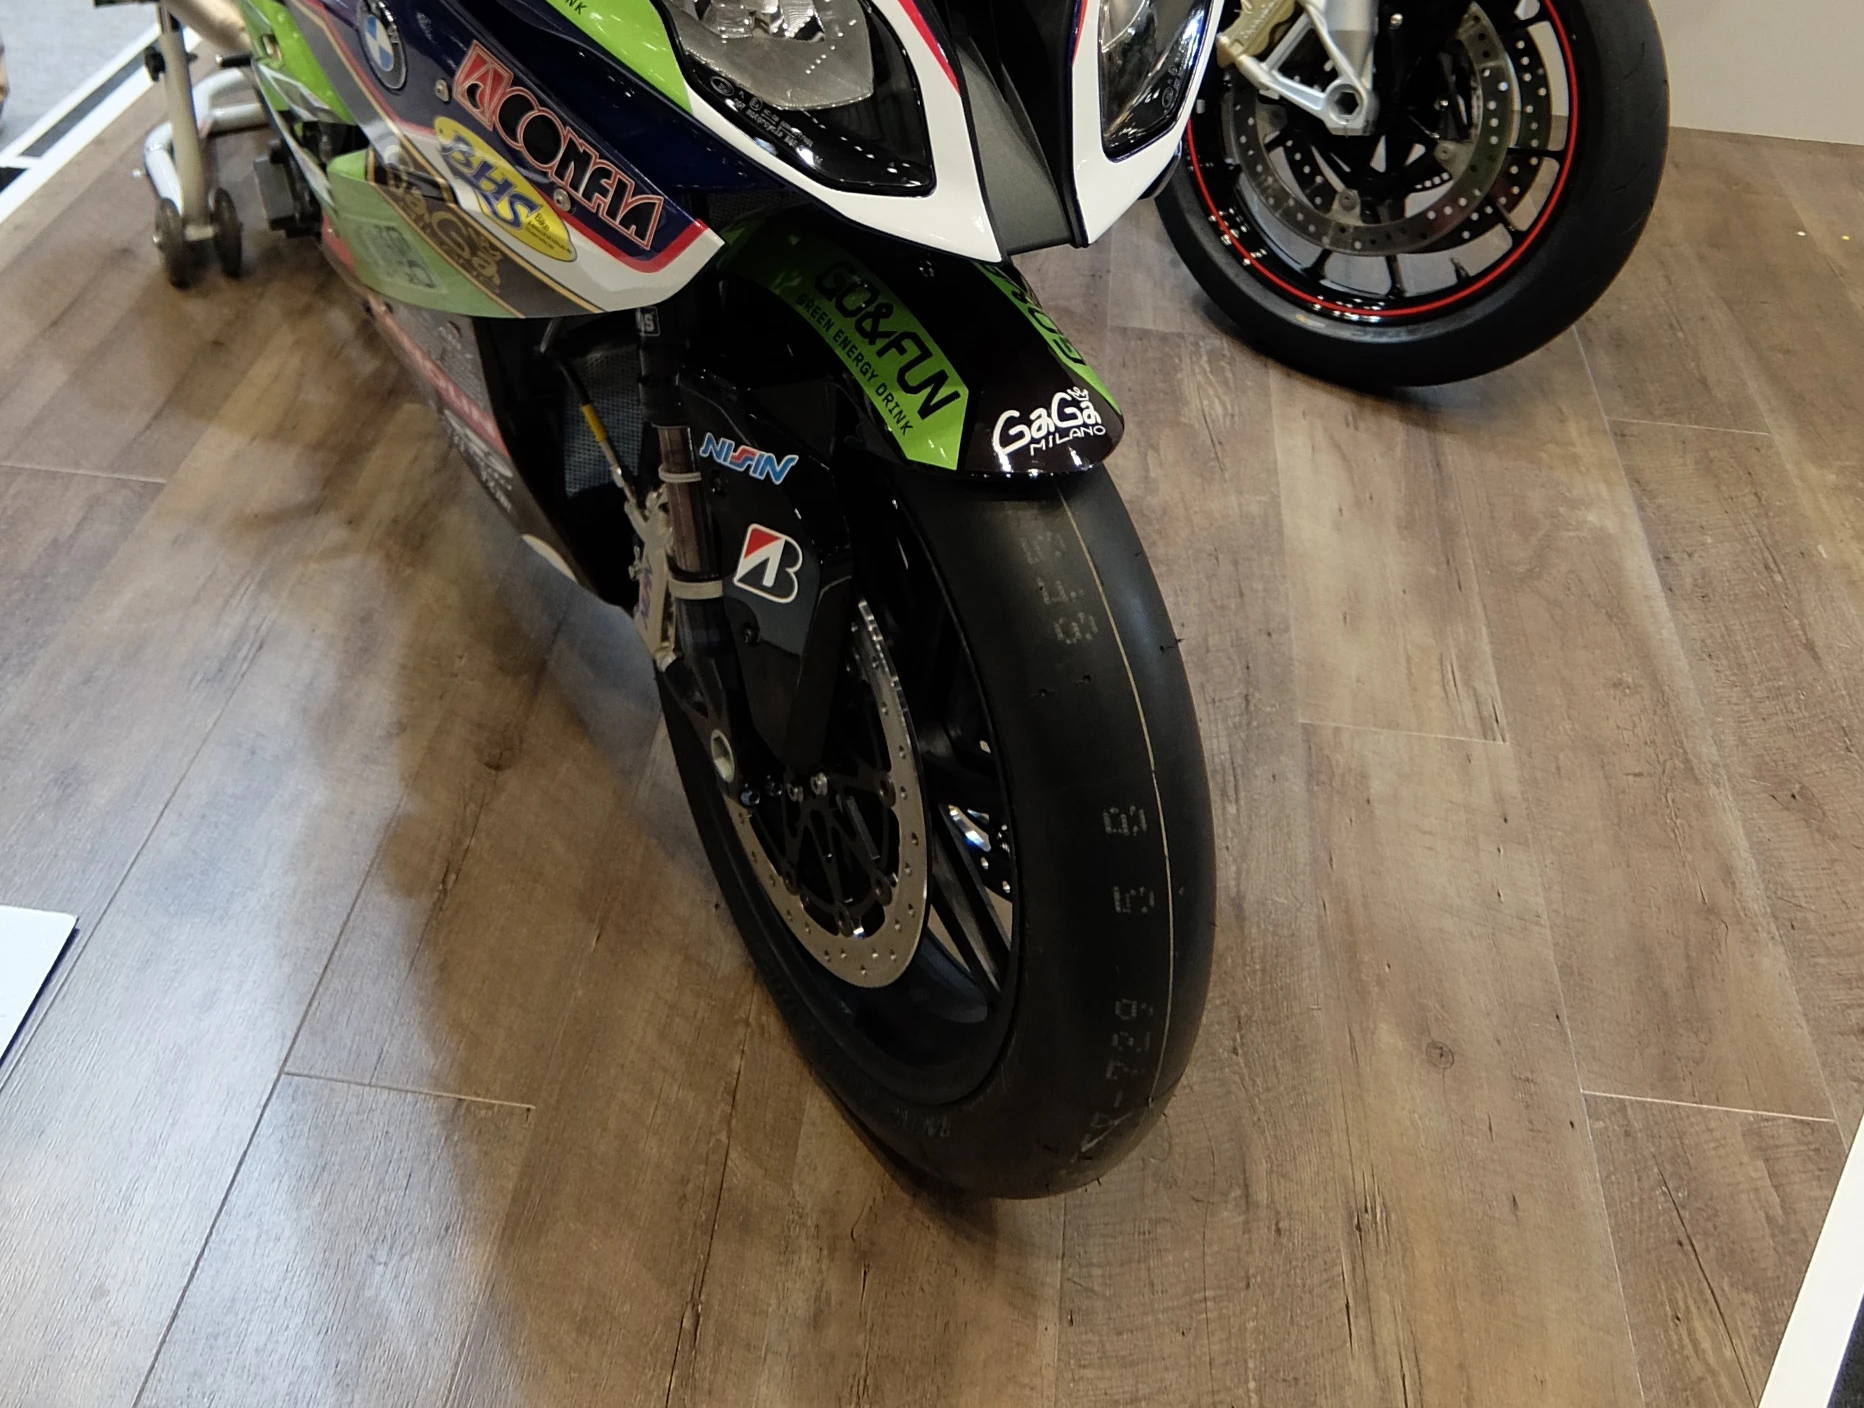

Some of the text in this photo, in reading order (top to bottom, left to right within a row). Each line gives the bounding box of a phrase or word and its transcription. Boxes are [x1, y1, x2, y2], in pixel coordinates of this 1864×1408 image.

[440, 134, 543, 230] BHS
[795, 293, 914, 436] GREEN ENERGY DRINK
[814, 261, 961, 420] GO&FUN
[992, 392, 1102, 455] GaGa
[1029, 425, 1106, 456] MILANO
